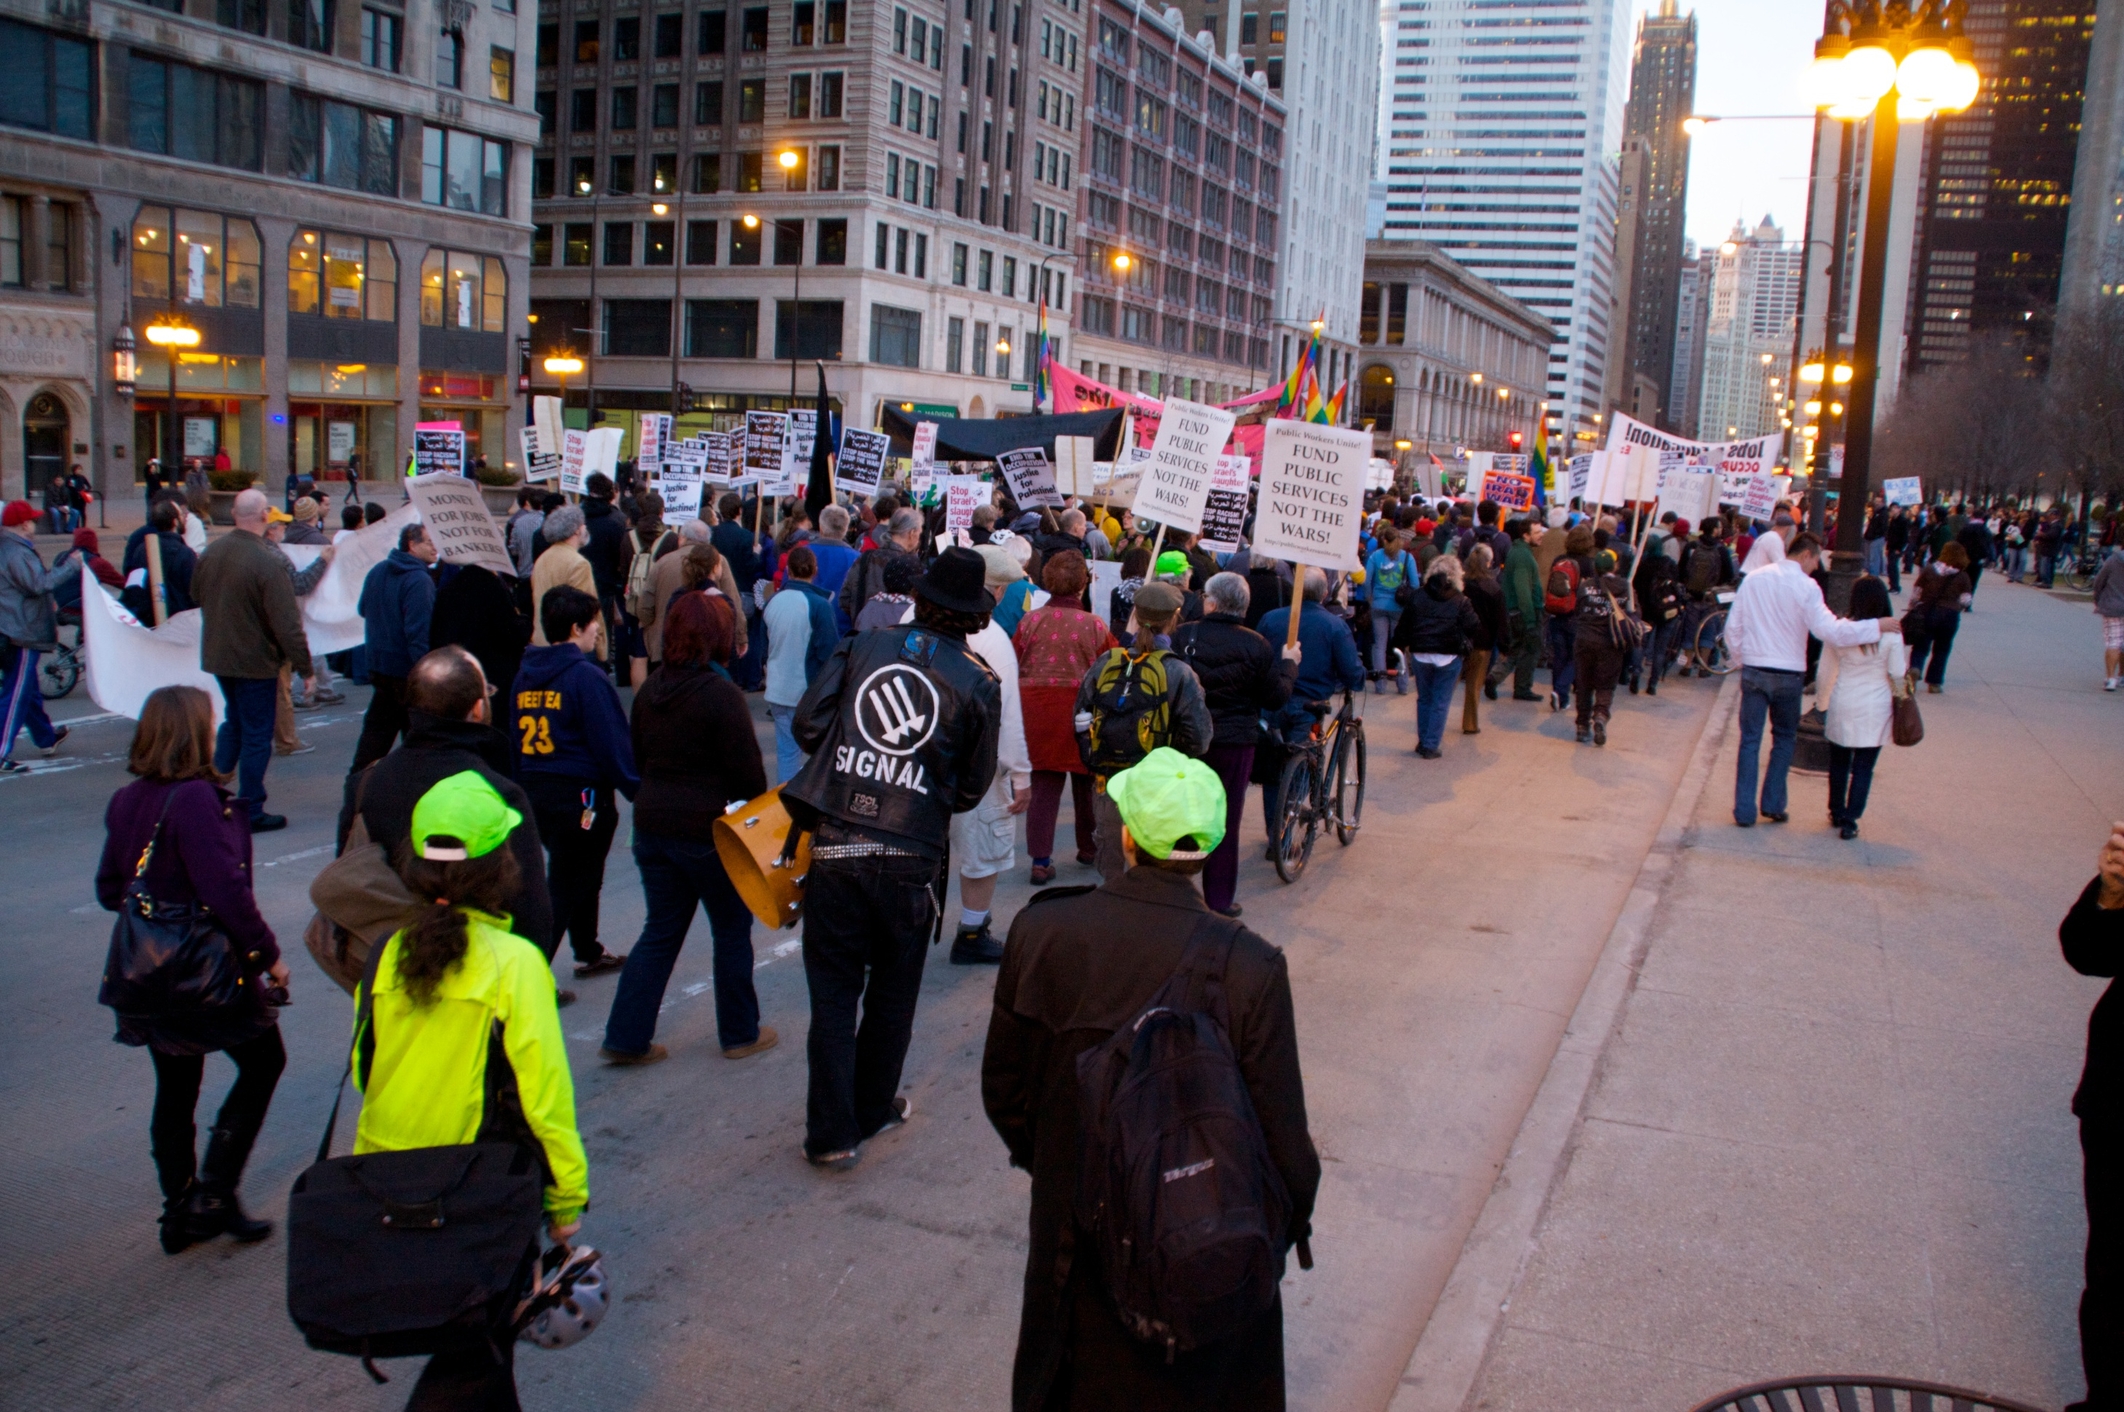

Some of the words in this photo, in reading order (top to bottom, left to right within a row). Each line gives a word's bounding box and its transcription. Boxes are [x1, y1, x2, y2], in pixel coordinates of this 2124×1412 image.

[1170, 402, 1188, 414] Public
[1189, 407, 1209, 420] Workers
[1210, 412, 1231, 425] Unite!
[1178, 418, 1209, 436] FUND
[1168, 434, 1209, 456] PUBLIC
[1275, 428, 1302, 439] Public
[1303, 431, 1335, 445] Workers
[1336, 438, 1362, 450] Unite!
[800, 443, 808, 452] for
[842, 447, 858, 455] STOP
[857, 450, 879, 460] RACISM!
[1456, 446, 1465, 457] P
[842, 453, 856, 461] STOP
[856, 456, 866, 464] THE
[1008, 452, 1024, 462] END
[1023, 452, 1036, 460] THE
[1292, 444, 1340, 465] FUND
[670, 464, 681, 472] END
[682, 465, 693, 473] THE
[1005, 459, 1046, 471] OCCUPATION
[1156, 450, 1209, 475] SERVICES
[663, 472, 700, 482] OCCUPATION
[1013, 468, 1040, 482] Justice
[1152, 468, 1177, 487] NOT
[1177, 473, 1202, 493] THE
[1283, 462, 1343, 487] PUBLIC
[1496, 475, 1522, 487] NO
[1752, 476, 1764, 486] Stop
[664, 482, 688, 493] Justice
[950, 485, 969, 497] Stop
[1020, 480, 1033, 489] for
[1485, 483, 1529, 499] IRAQ
[666, 494, 677, 502] for
[1017, 484, 1057, 501] Palestine!
[1154, 487, 1190, 509] WARS!
[1271, 480, 1349, 508] SERVICES
[1747, 491, 1774, 503] slaughter
[427, 494, 474, 507] MONEY
[950, 496, 977, 506] Israel's
[1485, 492, 1526, 507] WAR
[664, 502, 697, 513] alestine!
[1216, 509, 1240, 518] RACISM!
[1271, 501, 1309, 519] NOT
[1311, 508, 1345, 527] THE
[430, 511, 457, 524] FOR
[459, 510, 488, 523] JOBS
[1215, 515, 1227, 523] THE
[1227, 517, 1242, 525] WAR!
[439, 526, 469, 540] NOT
[470, 527, 496, 539] FOR
[1280, 522, 1331, 544] WARS!
[518, 715, 555, 755] 23
[835, 744, 928, 796] SIGNAL
